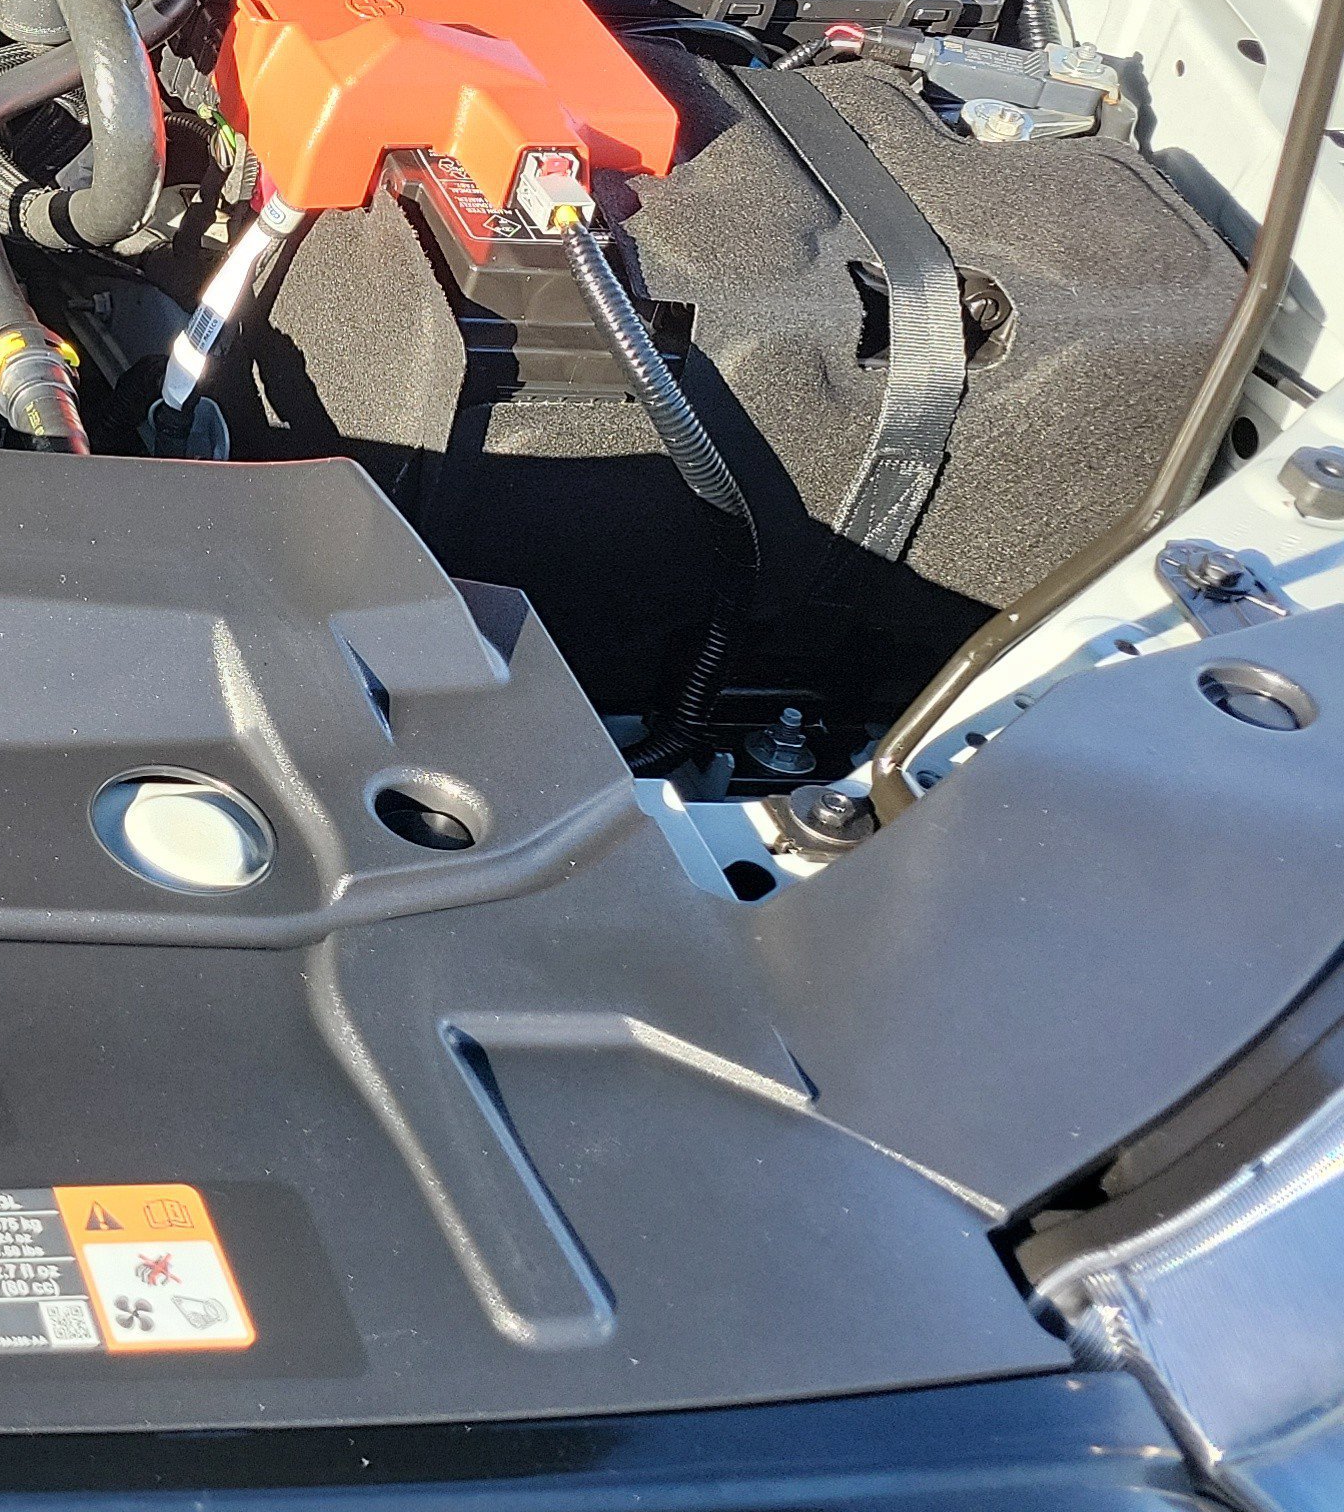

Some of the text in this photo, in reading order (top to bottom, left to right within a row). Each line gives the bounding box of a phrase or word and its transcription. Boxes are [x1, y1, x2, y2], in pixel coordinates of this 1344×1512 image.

[19, 1216, 43, 1234] kg
[36, 1265, 61, 1279] oz
[31, 1277, 61, 1297] cc)
